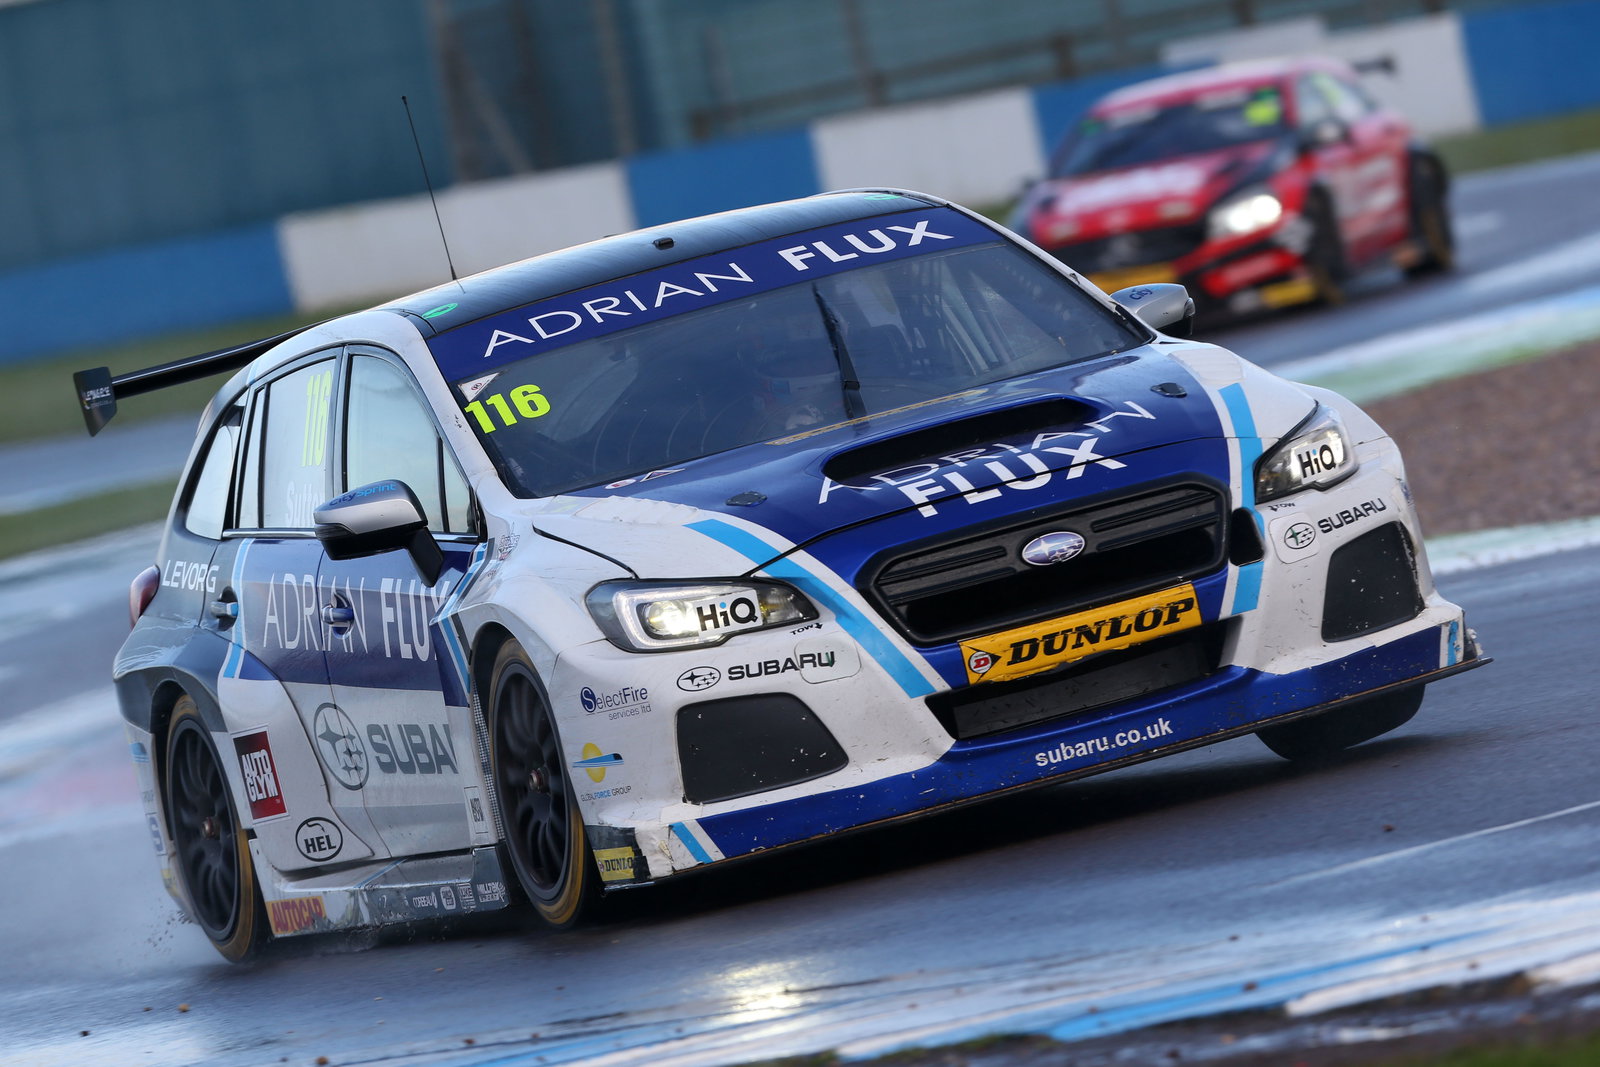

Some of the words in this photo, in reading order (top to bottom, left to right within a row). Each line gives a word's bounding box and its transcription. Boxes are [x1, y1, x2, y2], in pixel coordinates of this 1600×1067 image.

[484, 262, 754, 357] ADRIAN
[778, 220, 954, 271] FLUX
[302, 370, 332, 467] 116
[463, 384, 551, 434] 116
[818, 400, 1156, 504] ADRIAN
[1297, 444, 1336, 479] HiQ
[897, 437, 1128, 518] FLUX
[285, 480, 325, 528] Sutto
[1317, 498, 1387, 534] SUBARU
[162, 560, 219, 593] LEVORG
[263, 573, 369, 654] ADRIAN
[696, 597, 758, 632] HiQ
[790, 623, 813, 635] TOW
[1007, 597, 1195, 666] DUNLOP
[727, 650, 835, 681] SUBARU
[580, 686, 649, 713] SelectFire
[608, 707, 640, 721] services
[640, 704, 651, 714] ltd
[1035, 717, 1173, 767] subaru.co.uk
[241, 748, 273, 779] AUTO
[246, 773, 279, 802] GLYM
[611, 785, 632, 797] GROUP
[303, 834, 337, 854] HEL
[604, 856, 635, 872] DUNLO
